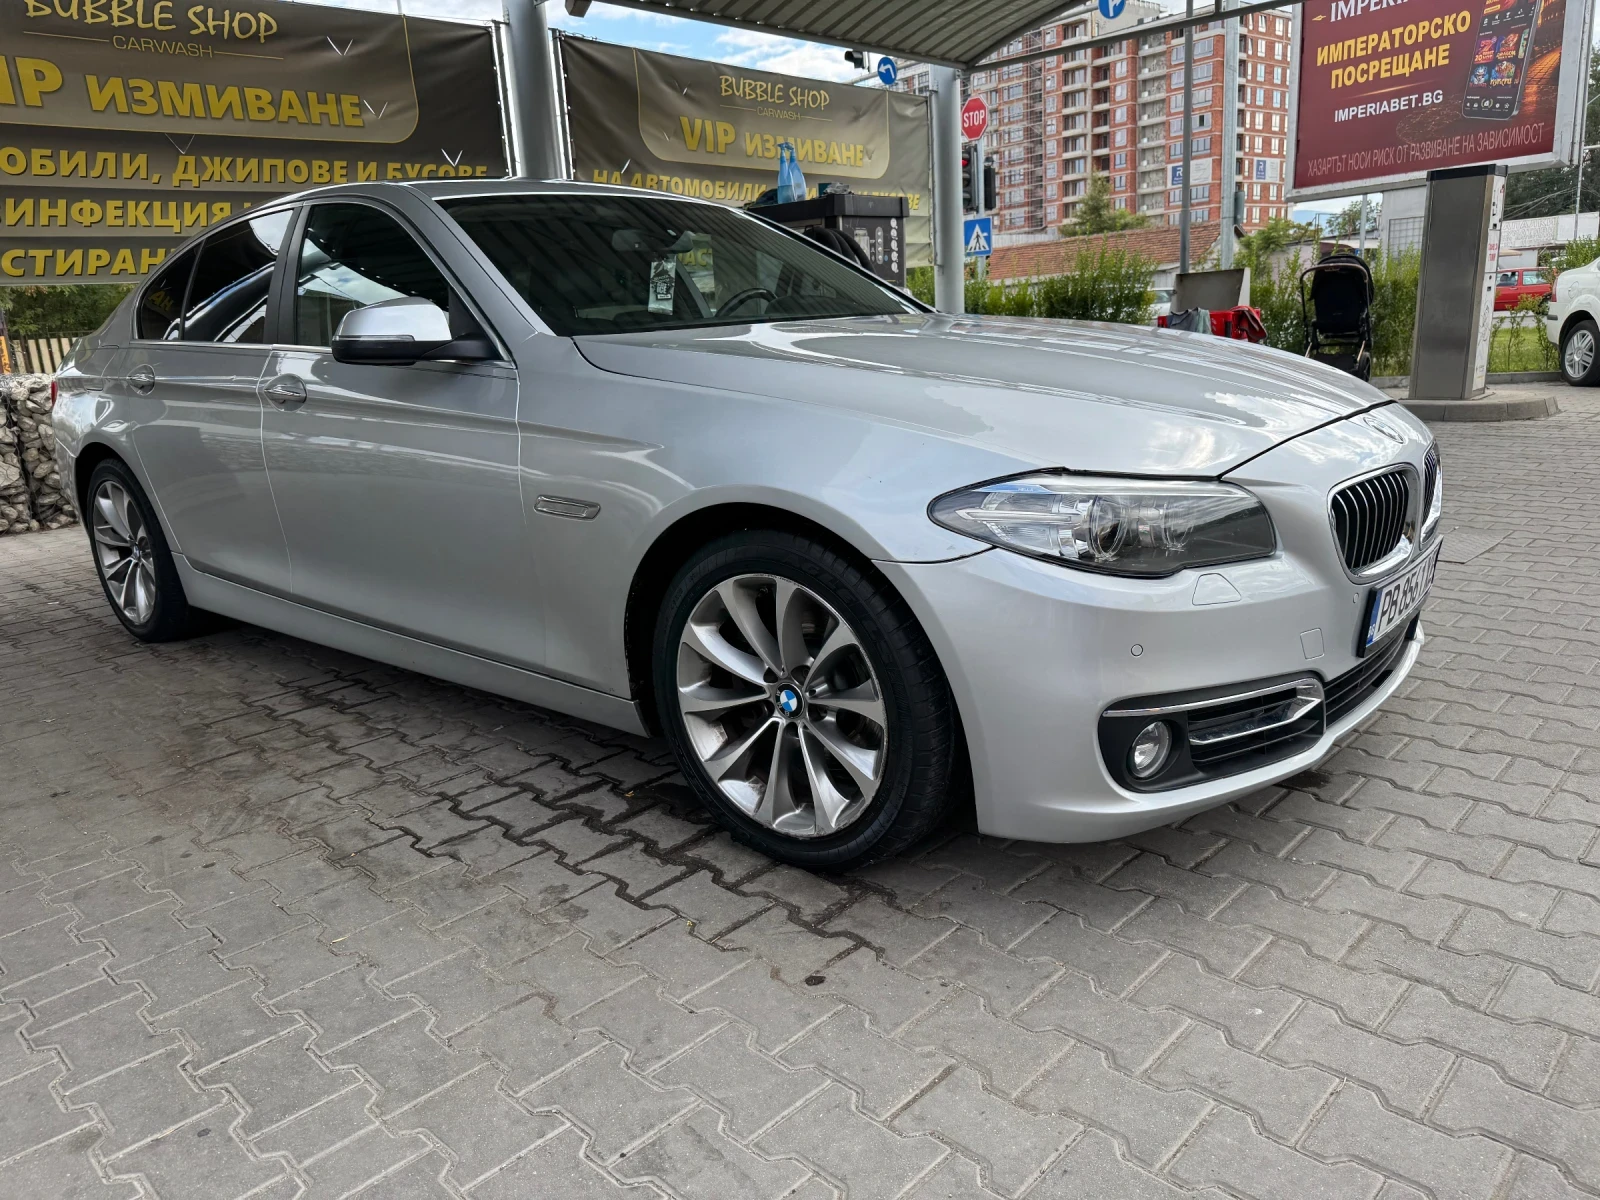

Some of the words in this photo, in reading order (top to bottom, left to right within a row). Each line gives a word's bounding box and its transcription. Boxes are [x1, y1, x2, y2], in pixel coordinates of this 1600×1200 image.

[187, 5, 278, 43] SHOP
[1316, 10, 1471, 67] ИМПЕРАТОРСКО
[113, 35, 213, 58] CARWASH
[1330, 44, 1450, 89] ПОСРЕЩАНЕ
[85, 74, 365, 127] ИЗМИВАНЕ
[719, 75, 785, 104] BUBBLE
[789, 86, 830, 111] SHOP
[1334, 90, 1443, 123] IMPERIABET.BG
[757, 107, 801, 120] CARWASH
[963, 108, 985, 128] STOP
[679, 116, 736, 154] VIP
[1307, 154, 1347, 177] ХАЗАРТЪТ
[1347, 150, 1371, 171] НОСИ
[1372, 147, 1395, 168] РИСК
[1396, 144, 1409, 164] ОТ
[1409, 136, 1461, 162] РАЗВИВАНЕ
[1462, 133, 1476, 153] НА
[1477, 122, 1545, 152] ЗАВИСИМОСТ
[172, 155, 349, 187] ДЖИПОВЕ
[357, 161, 378, 182] И
[0, 198, 232, 234] ИНФЕКЦИЯ
[1, 249, 173, 277] СТИРАН
[1378, 584, 1401, 633] PB
